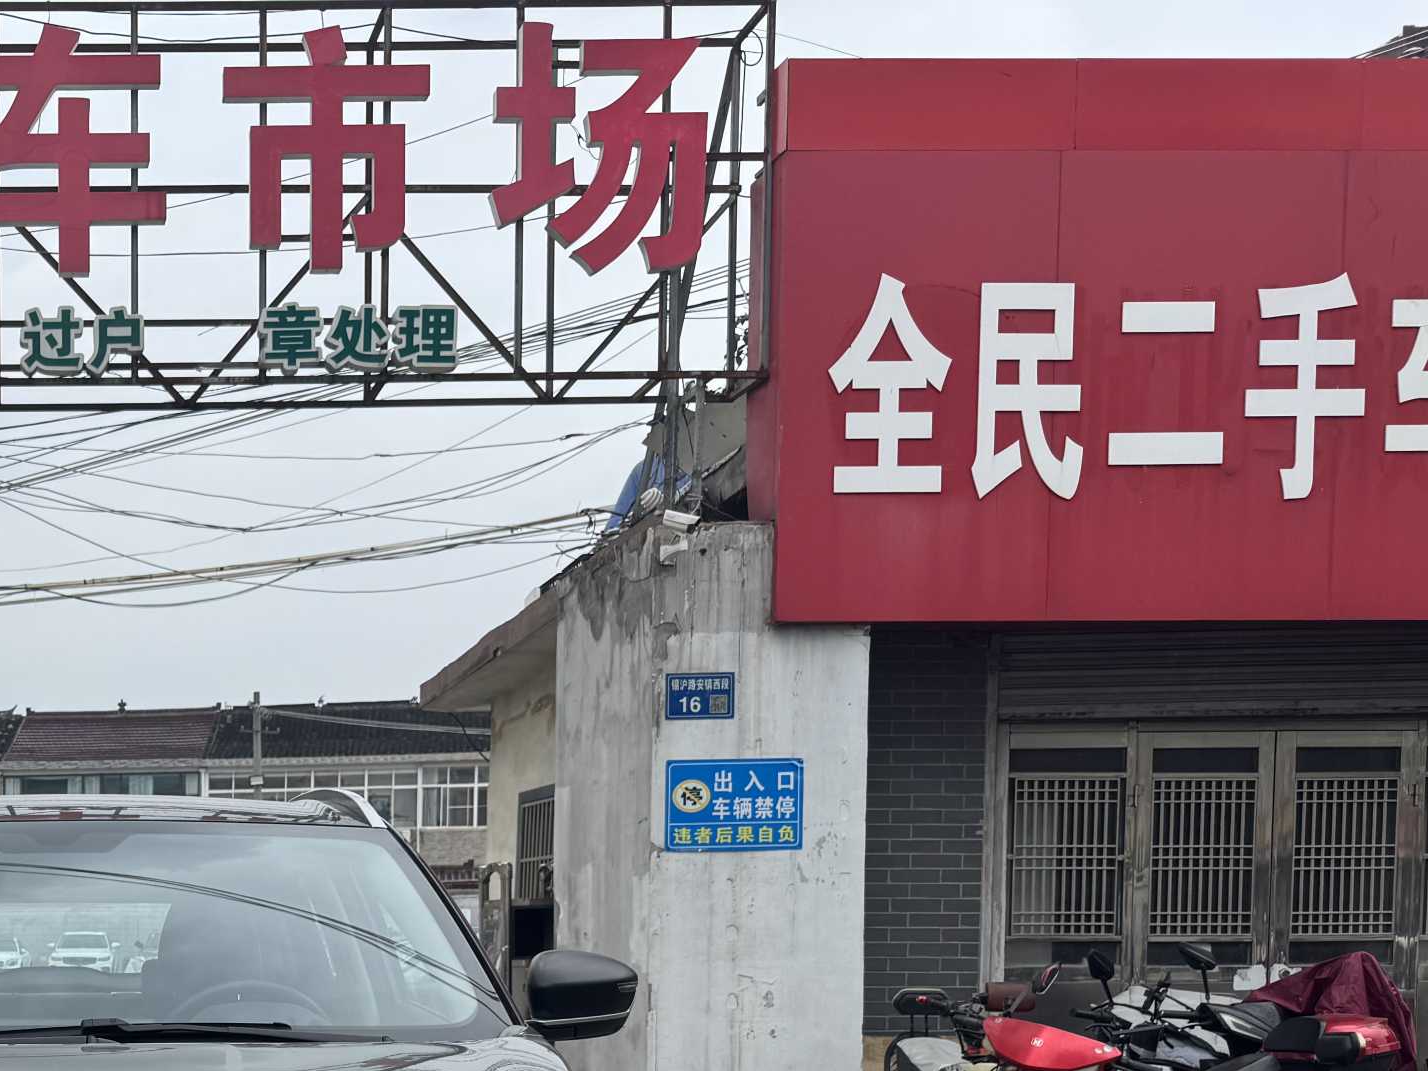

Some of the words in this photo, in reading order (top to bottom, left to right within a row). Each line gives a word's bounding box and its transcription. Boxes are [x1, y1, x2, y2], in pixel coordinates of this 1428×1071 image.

[25, 308, 142, 370] 过户
[262, 305, 457, 368] 章处理
[678, 696, 701, 713] 16
[713, 770, 795, 793] 出入口
[712, 795, 795, 820] 车辆禁停
[673, 825, 795, 845] 违者后果自负
